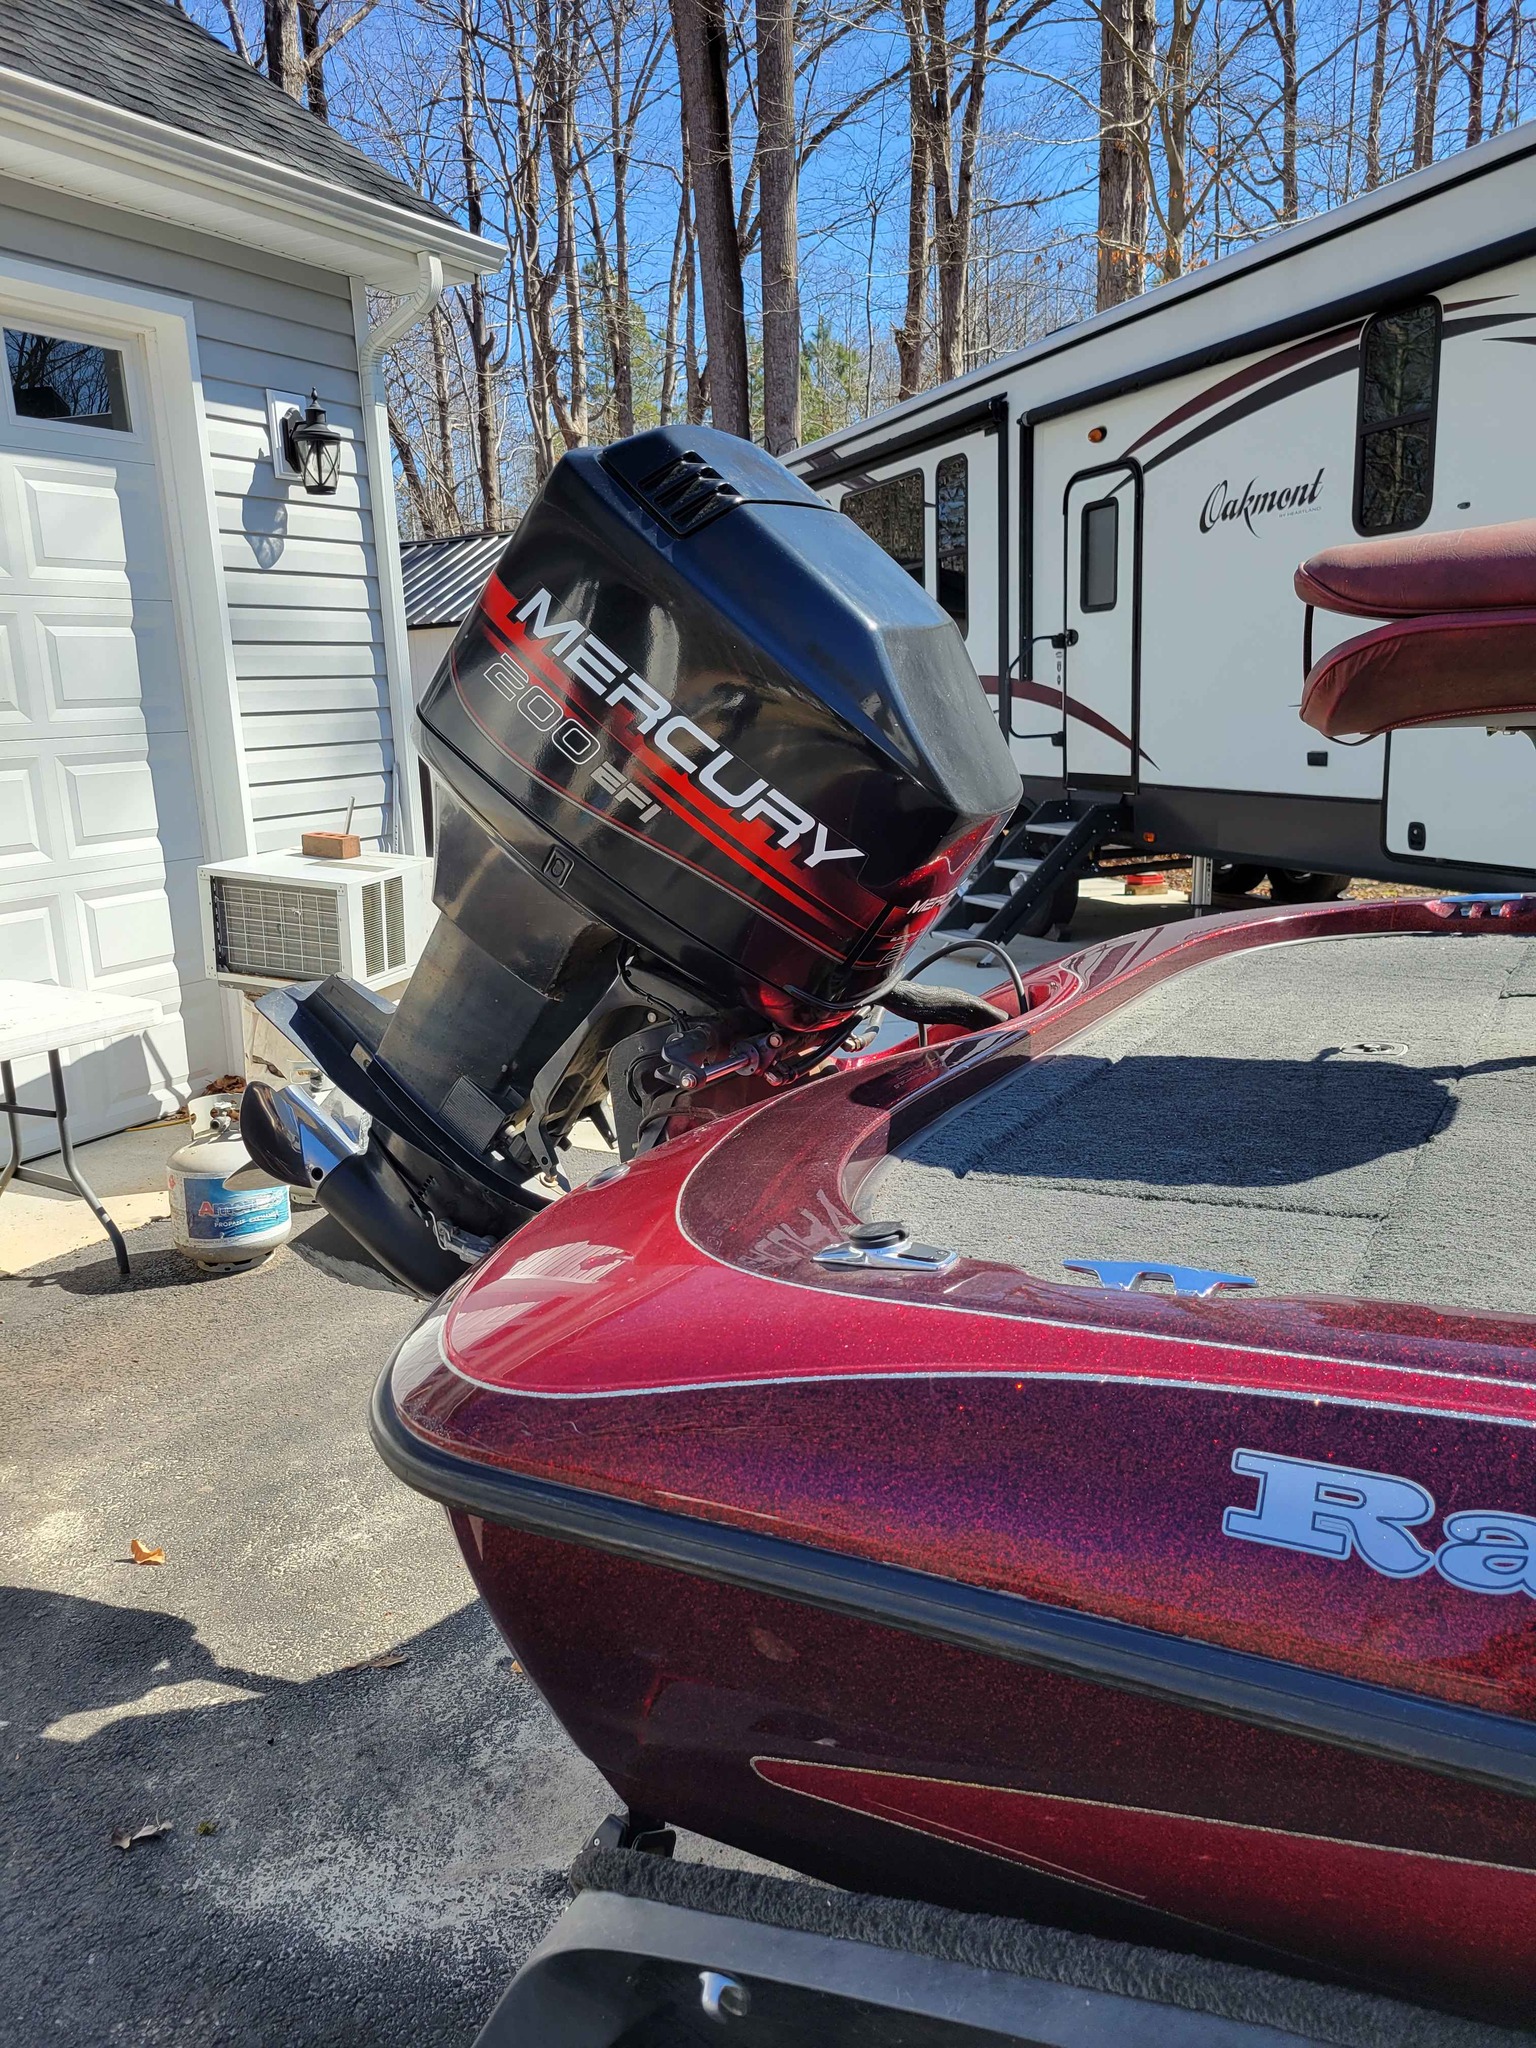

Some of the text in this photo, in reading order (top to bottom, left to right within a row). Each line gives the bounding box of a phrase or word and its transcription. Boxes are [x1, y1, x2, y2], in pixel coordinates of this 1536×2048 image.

[1199, 467, 1325, 538] Oakmont
[483, 653, 662, 823] 200 EFI
[516, 588, 866, 868] MERCURY
